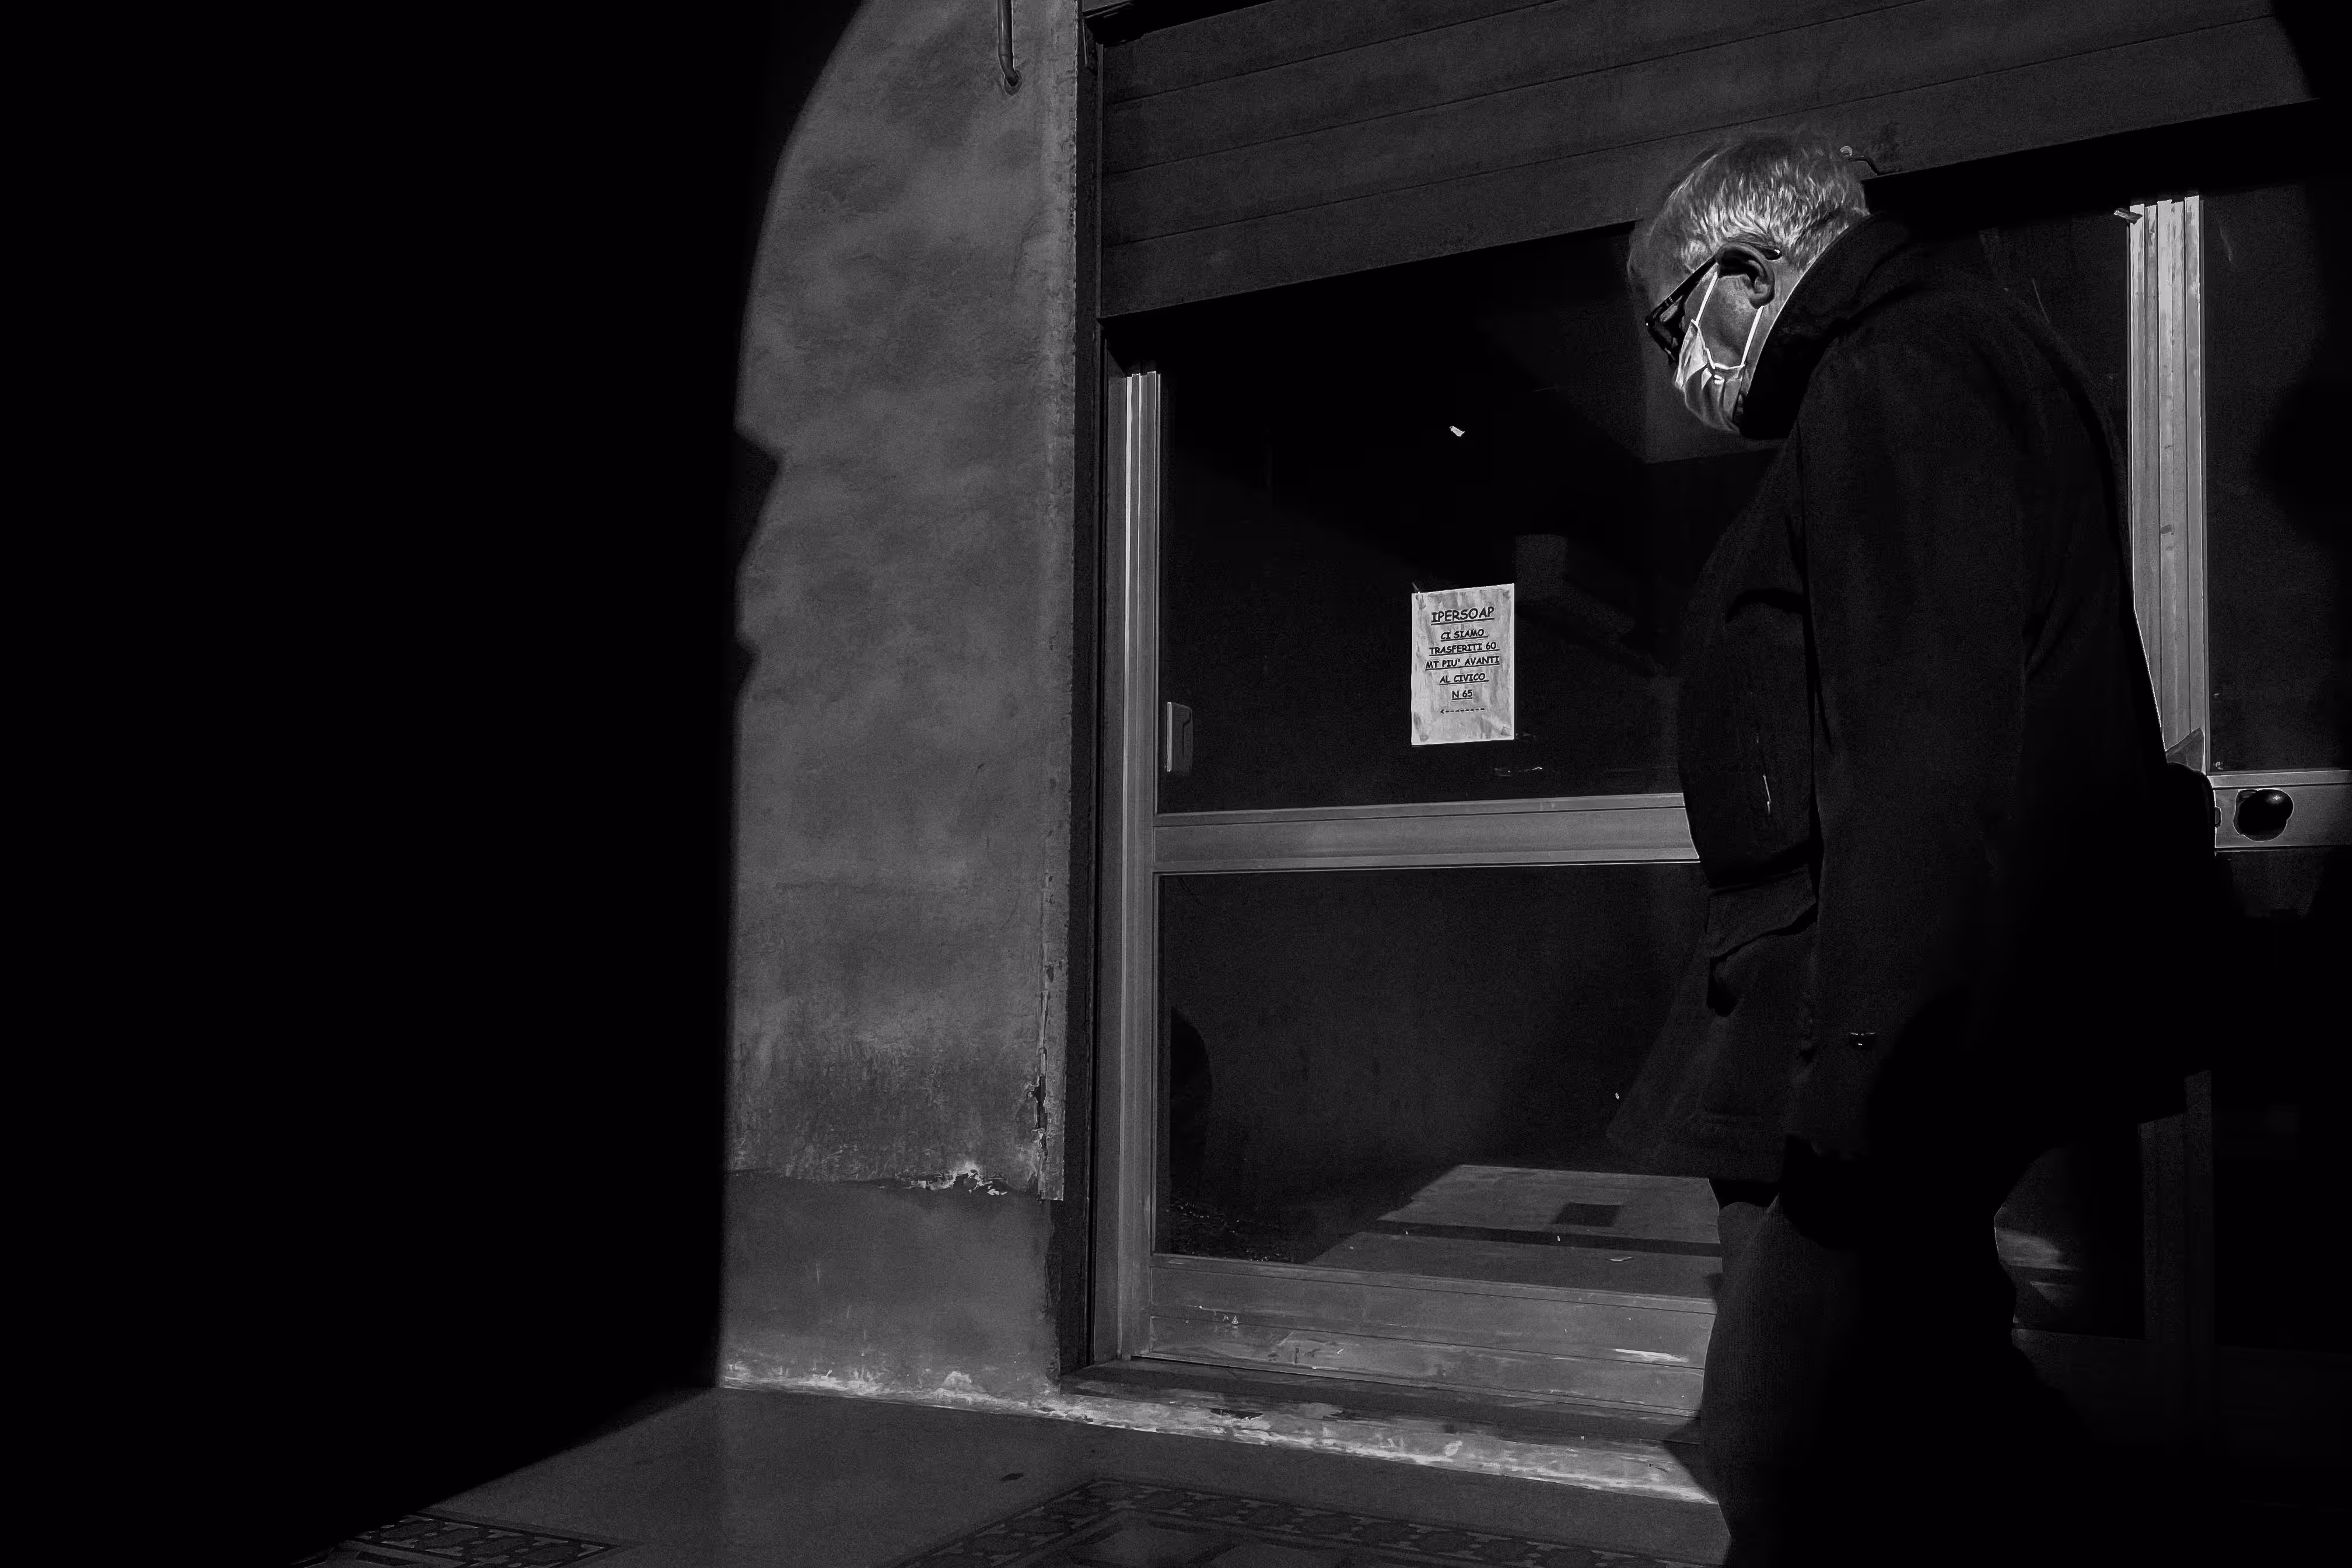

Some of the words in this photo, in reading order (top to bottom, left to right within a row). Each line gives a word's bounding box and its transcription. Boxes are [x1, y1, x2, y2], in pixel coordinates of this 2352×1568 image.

[1431, 606, 1494, 622] IPERSOAP
[1441, 632, 1451, 640] CI
[1454, 629, 1484, 638] SIAMO
[1429, 643, 1482, 654] TRASFERITI
[1486, 642, 1496, 650] 60
[1426, 660, 1439, 669] MT
[1442, 659, 1461, 667] PIU'
[1465, 656, 1500, 666] AVANTI
[1440, 675, 1450, 684] AL
[1454, 673, 1486, 682] CIVICO
